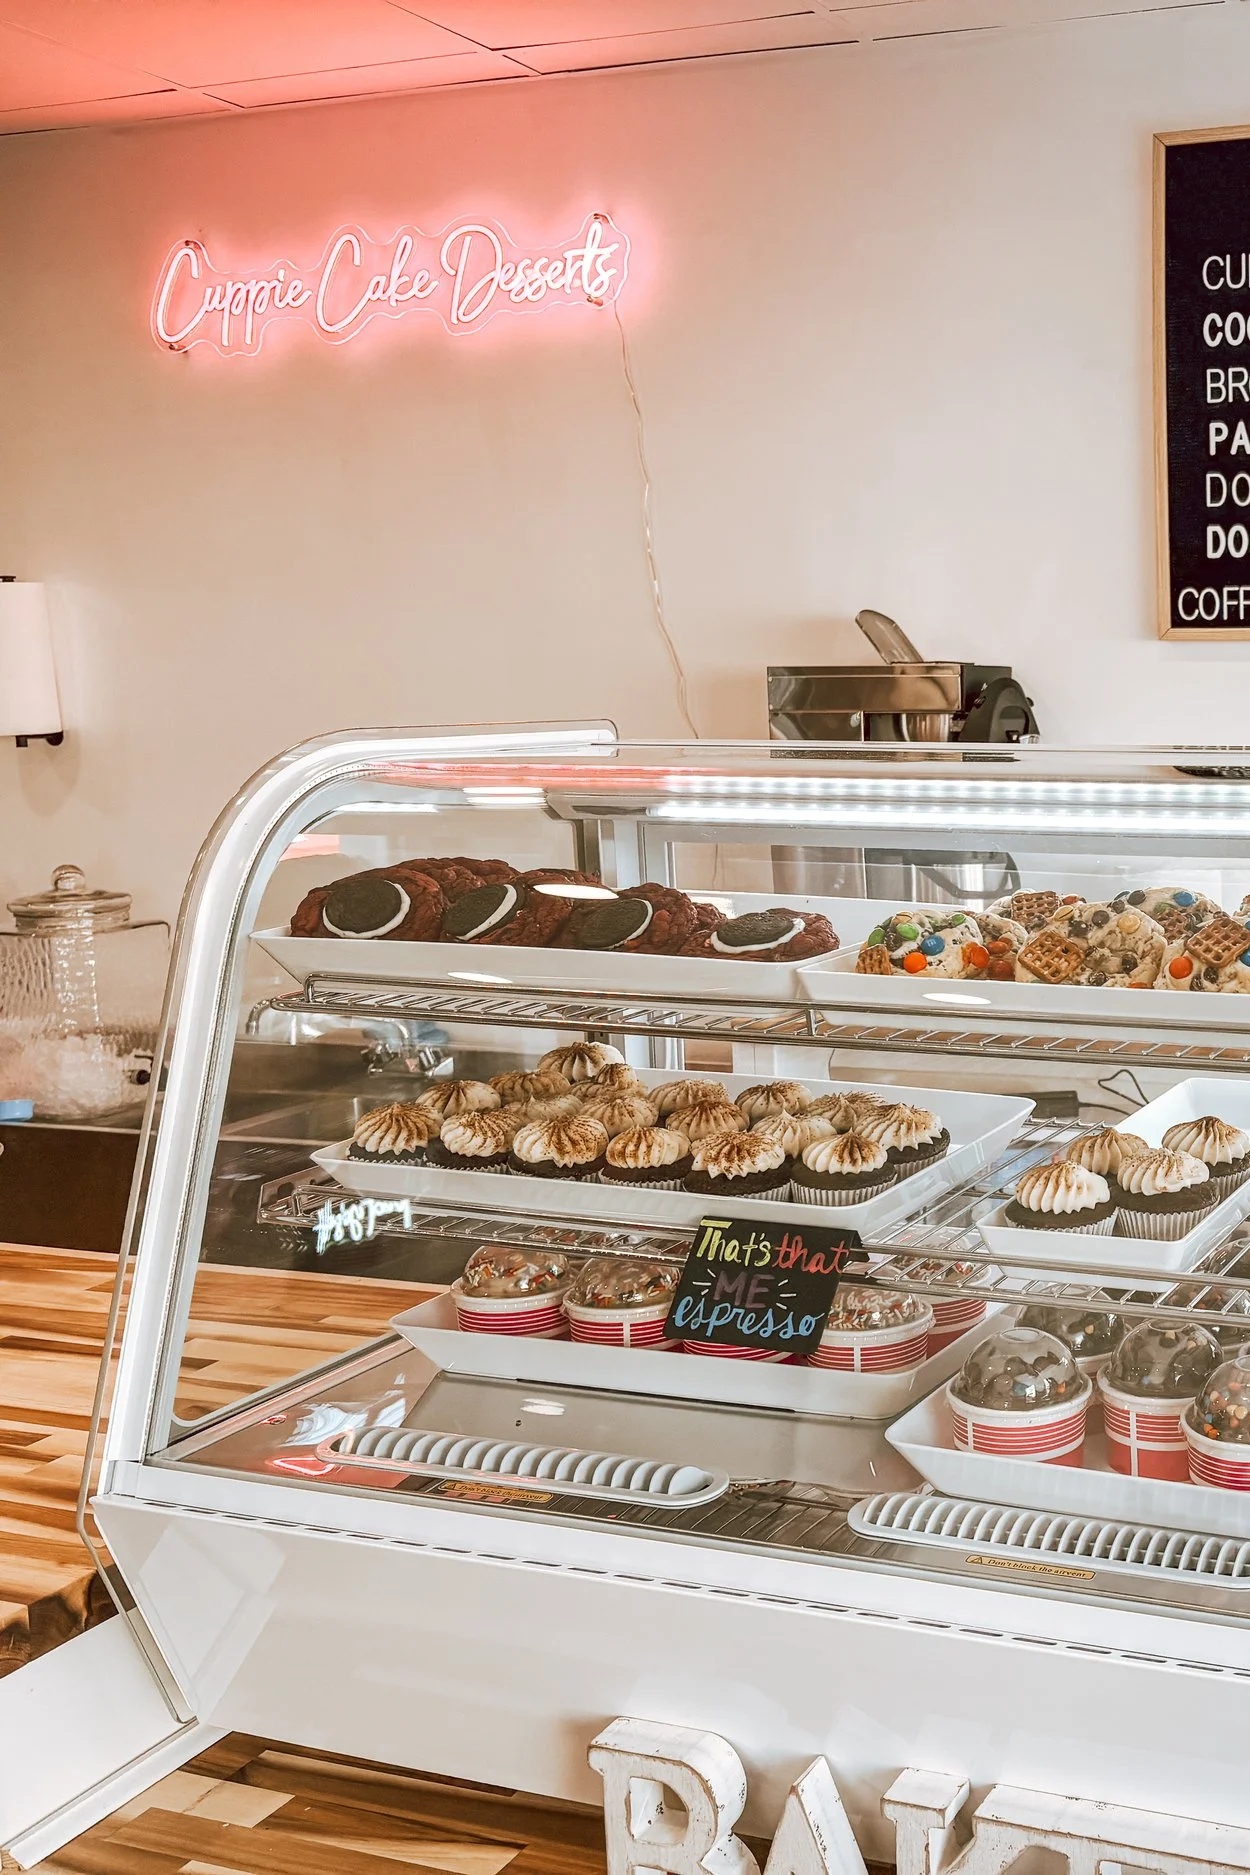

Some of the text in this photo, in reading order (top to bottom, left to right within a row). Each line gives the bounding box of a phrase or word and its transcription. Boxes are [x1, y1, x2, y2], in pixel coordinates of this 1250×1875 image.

[156, 222, 619, 347] Cuppie Cake Desserts
[696, 1219, 850, 1275] That's that
[713, 1270, 776, 1309] ME
[672, 1295, 826, 1340] espresso
